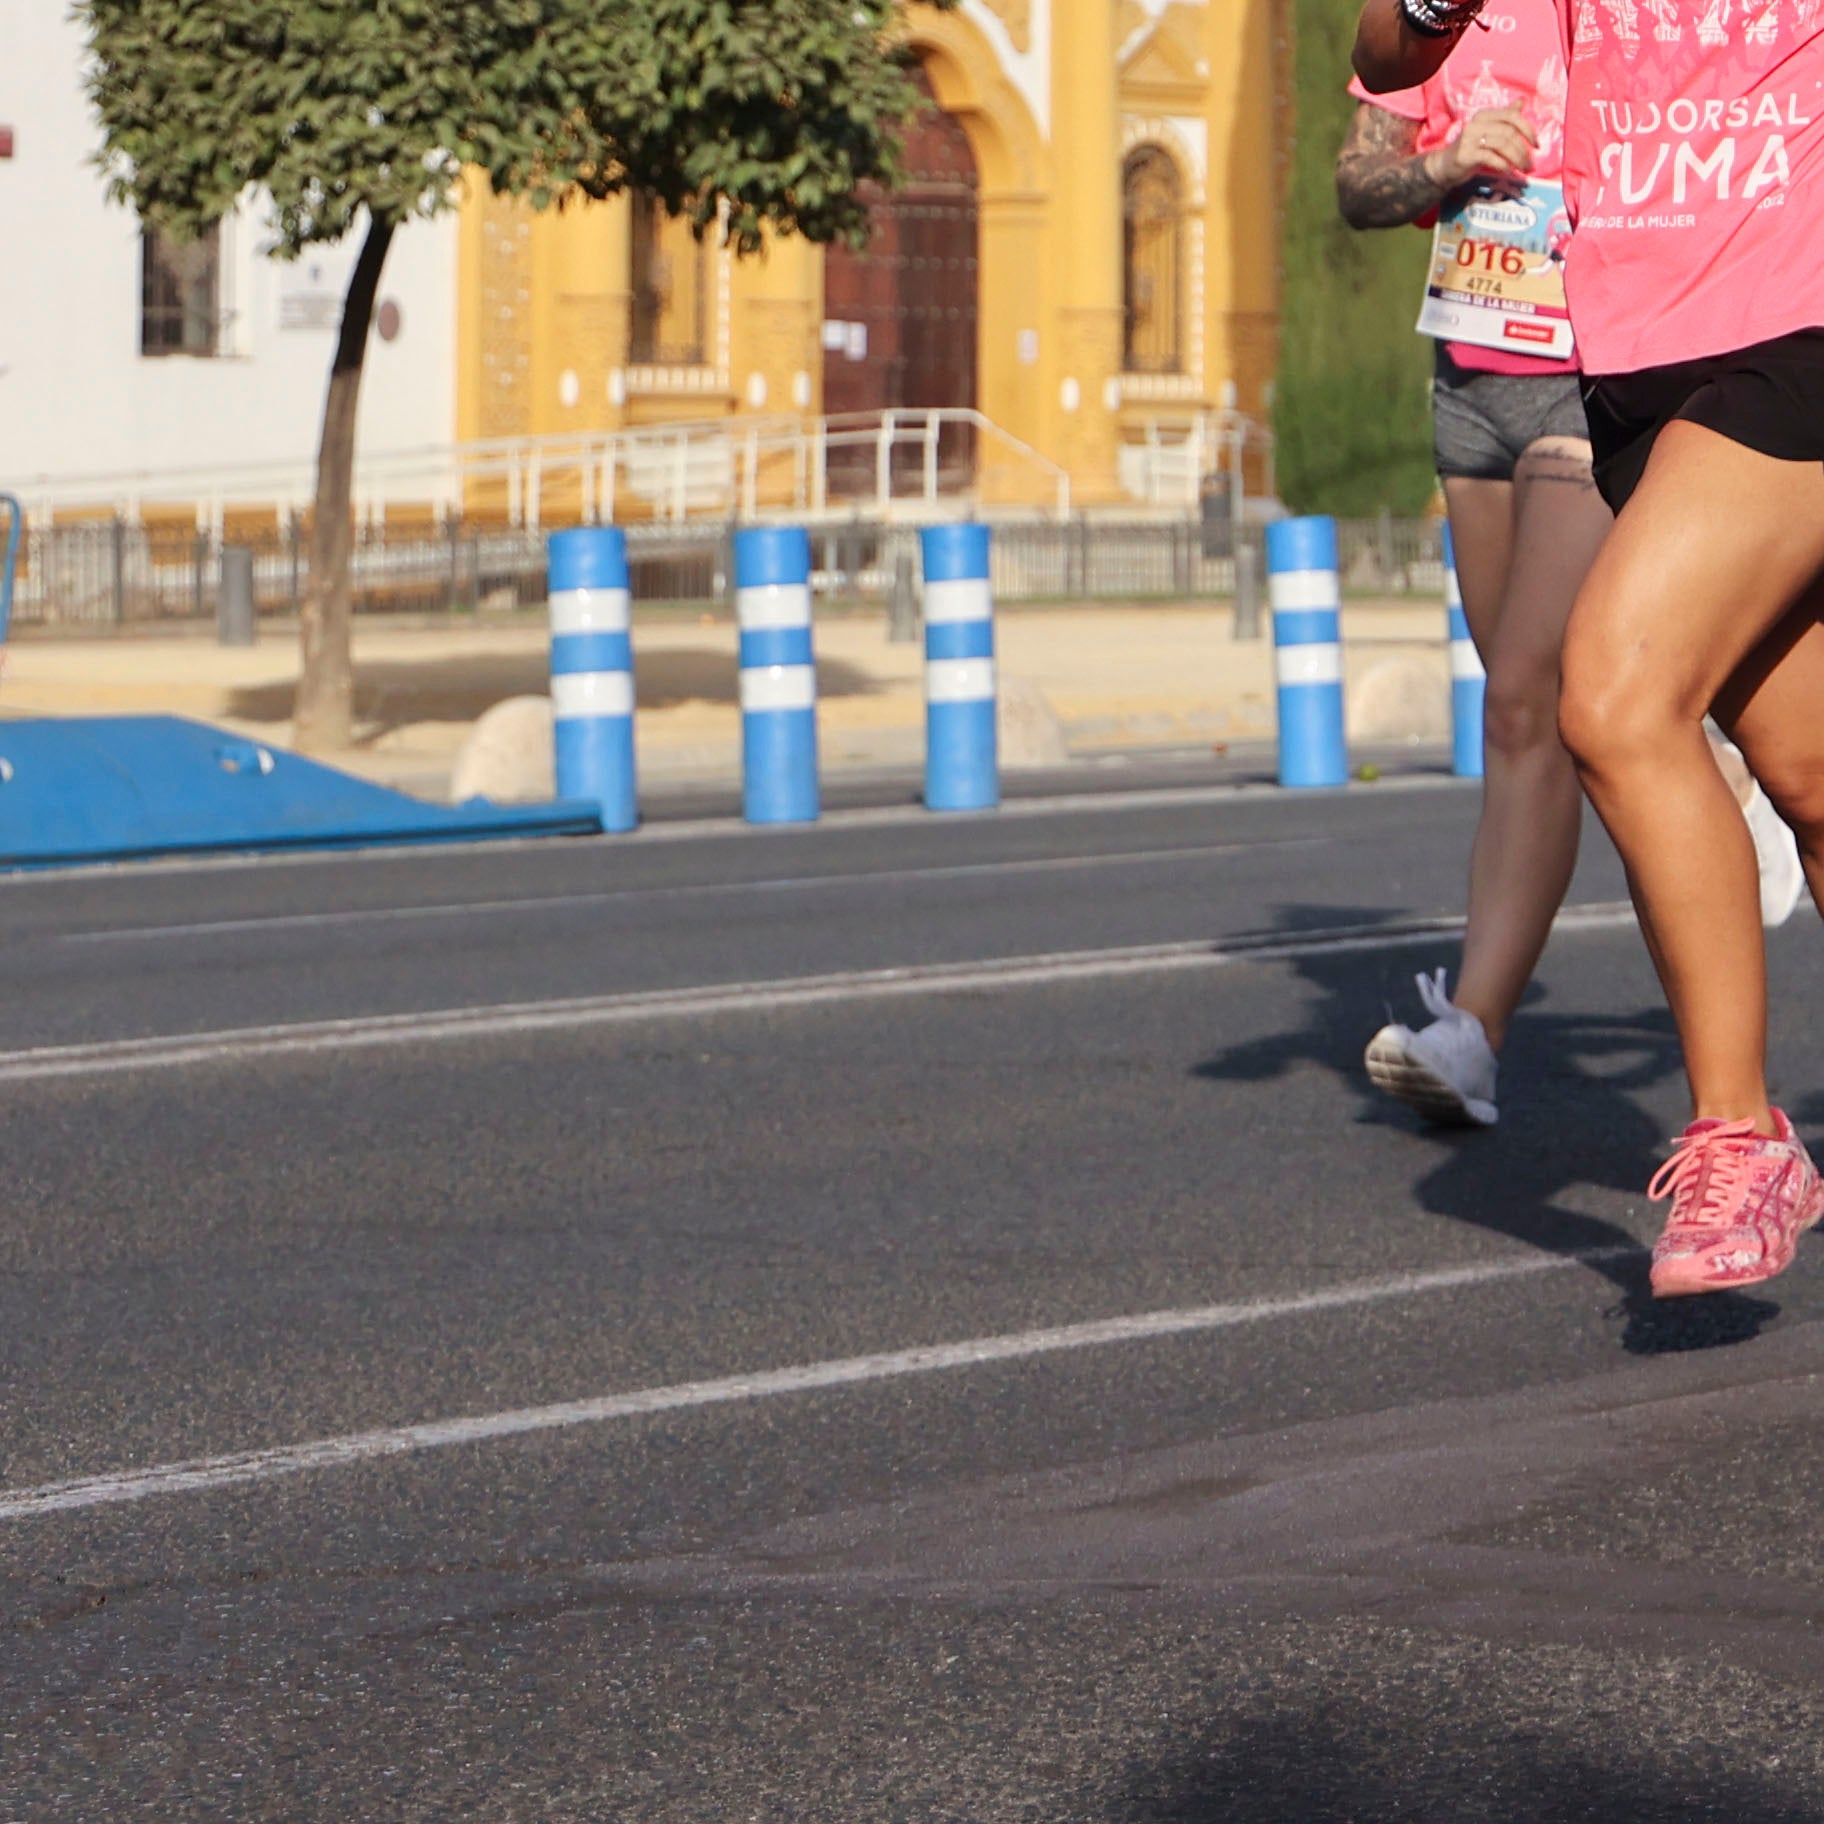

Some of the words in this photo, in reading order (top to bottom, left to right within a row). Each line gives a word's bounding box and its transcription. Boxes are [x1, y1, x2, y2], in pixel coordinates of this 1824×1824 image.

[1590, 92, 1811, 135] TUDORSAL
[1628, 214, 1645, 228] LA
[1649, 214, 1696, 228] MUJER
[1457, 239, 1524, 275] 016
[1467, 277, 1502, 294] 4774
